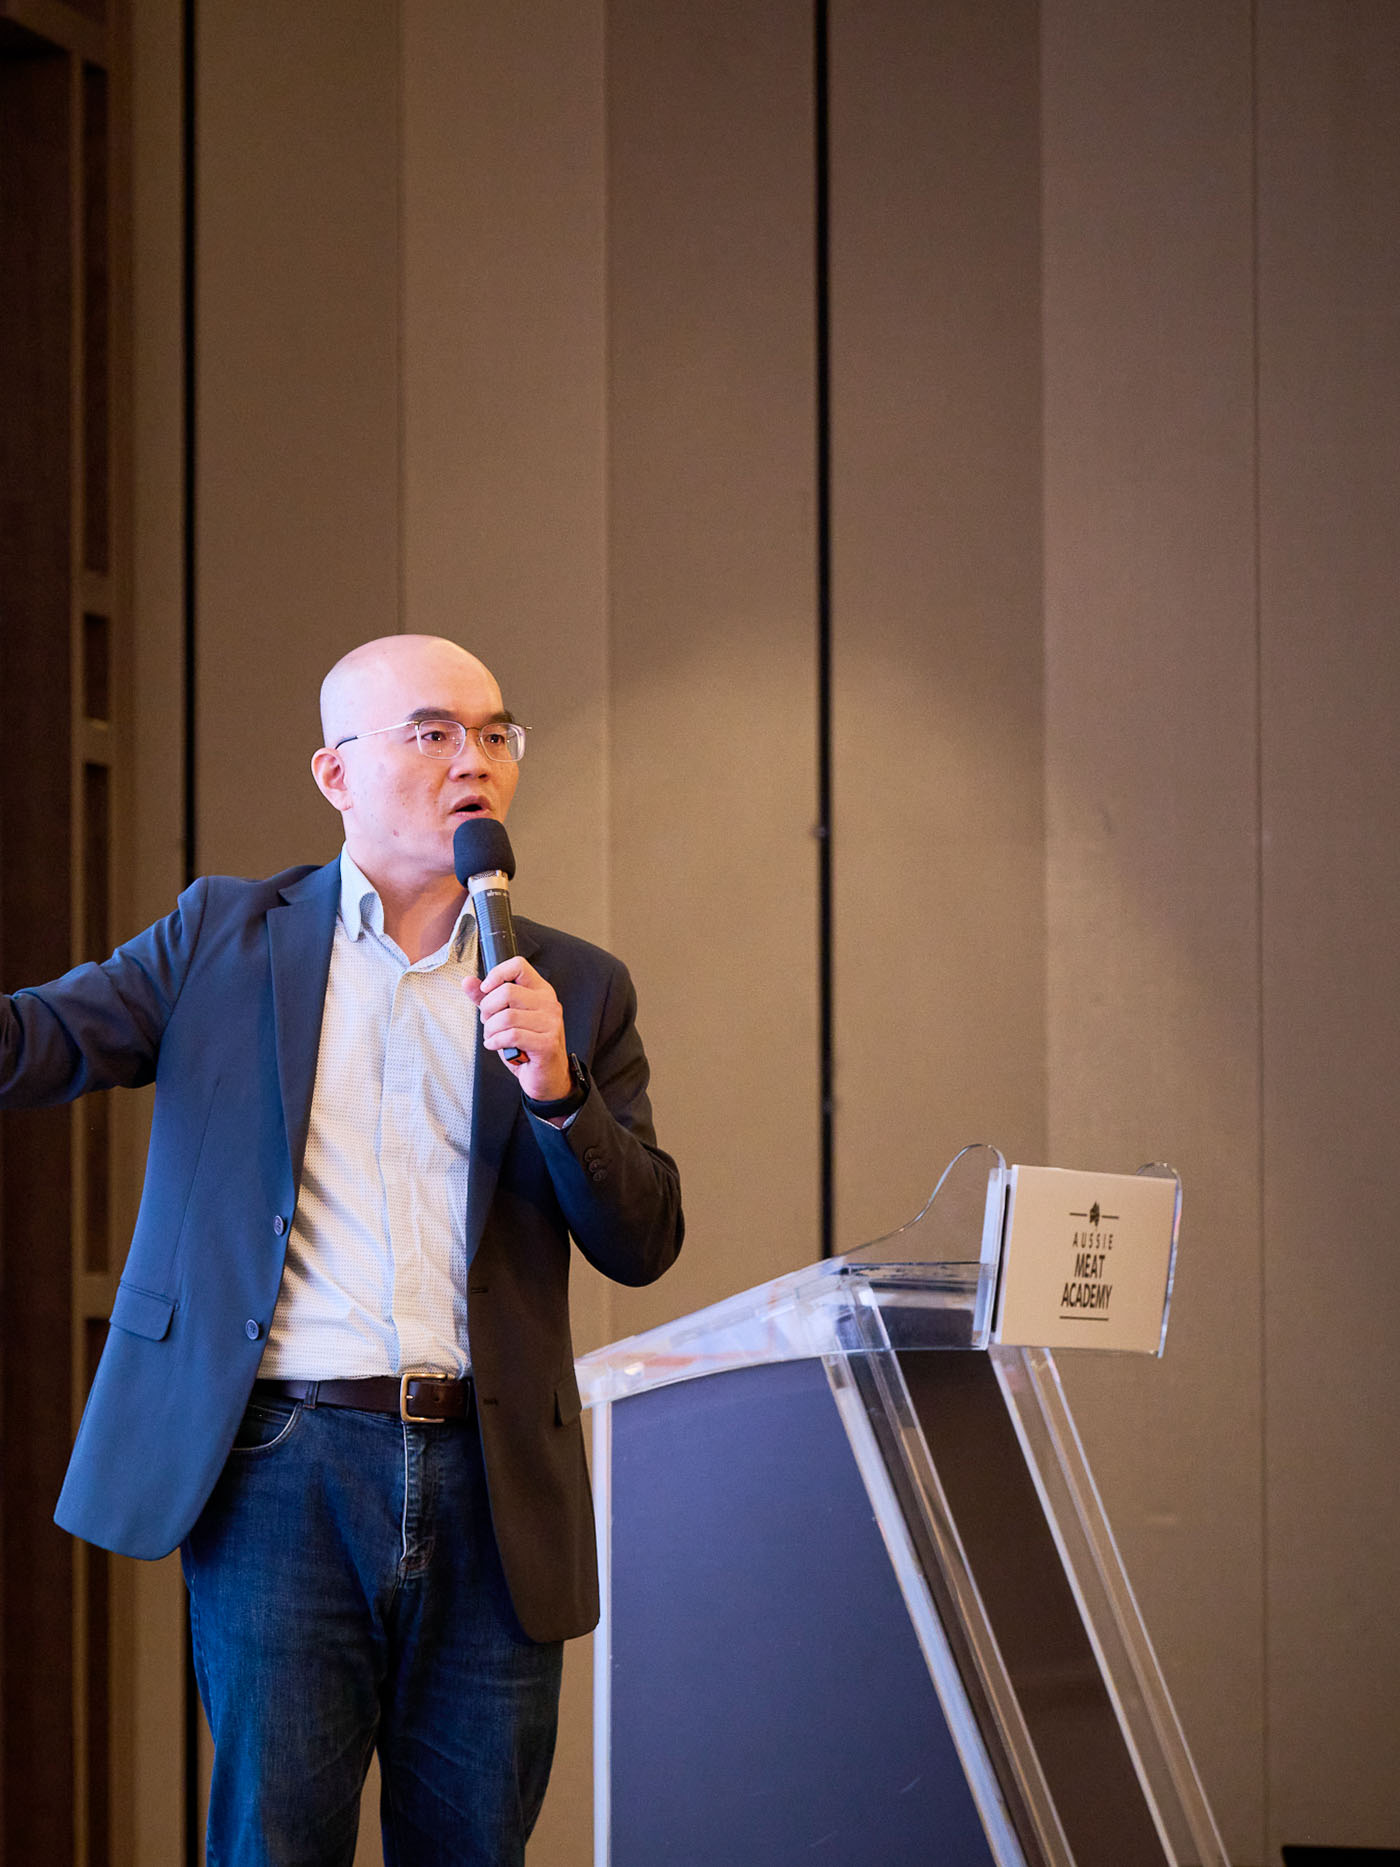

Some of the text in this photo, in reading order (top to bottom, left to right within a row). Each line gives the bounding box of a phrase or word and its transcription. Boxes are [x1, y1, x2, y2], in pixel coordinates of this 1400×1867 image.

[1072, 1231, 1114, 1251] AUSSIE
[1073, 1253, 1106, 1279] MEAT
[1060, 1282, 1113, 1310] ACADEMY
